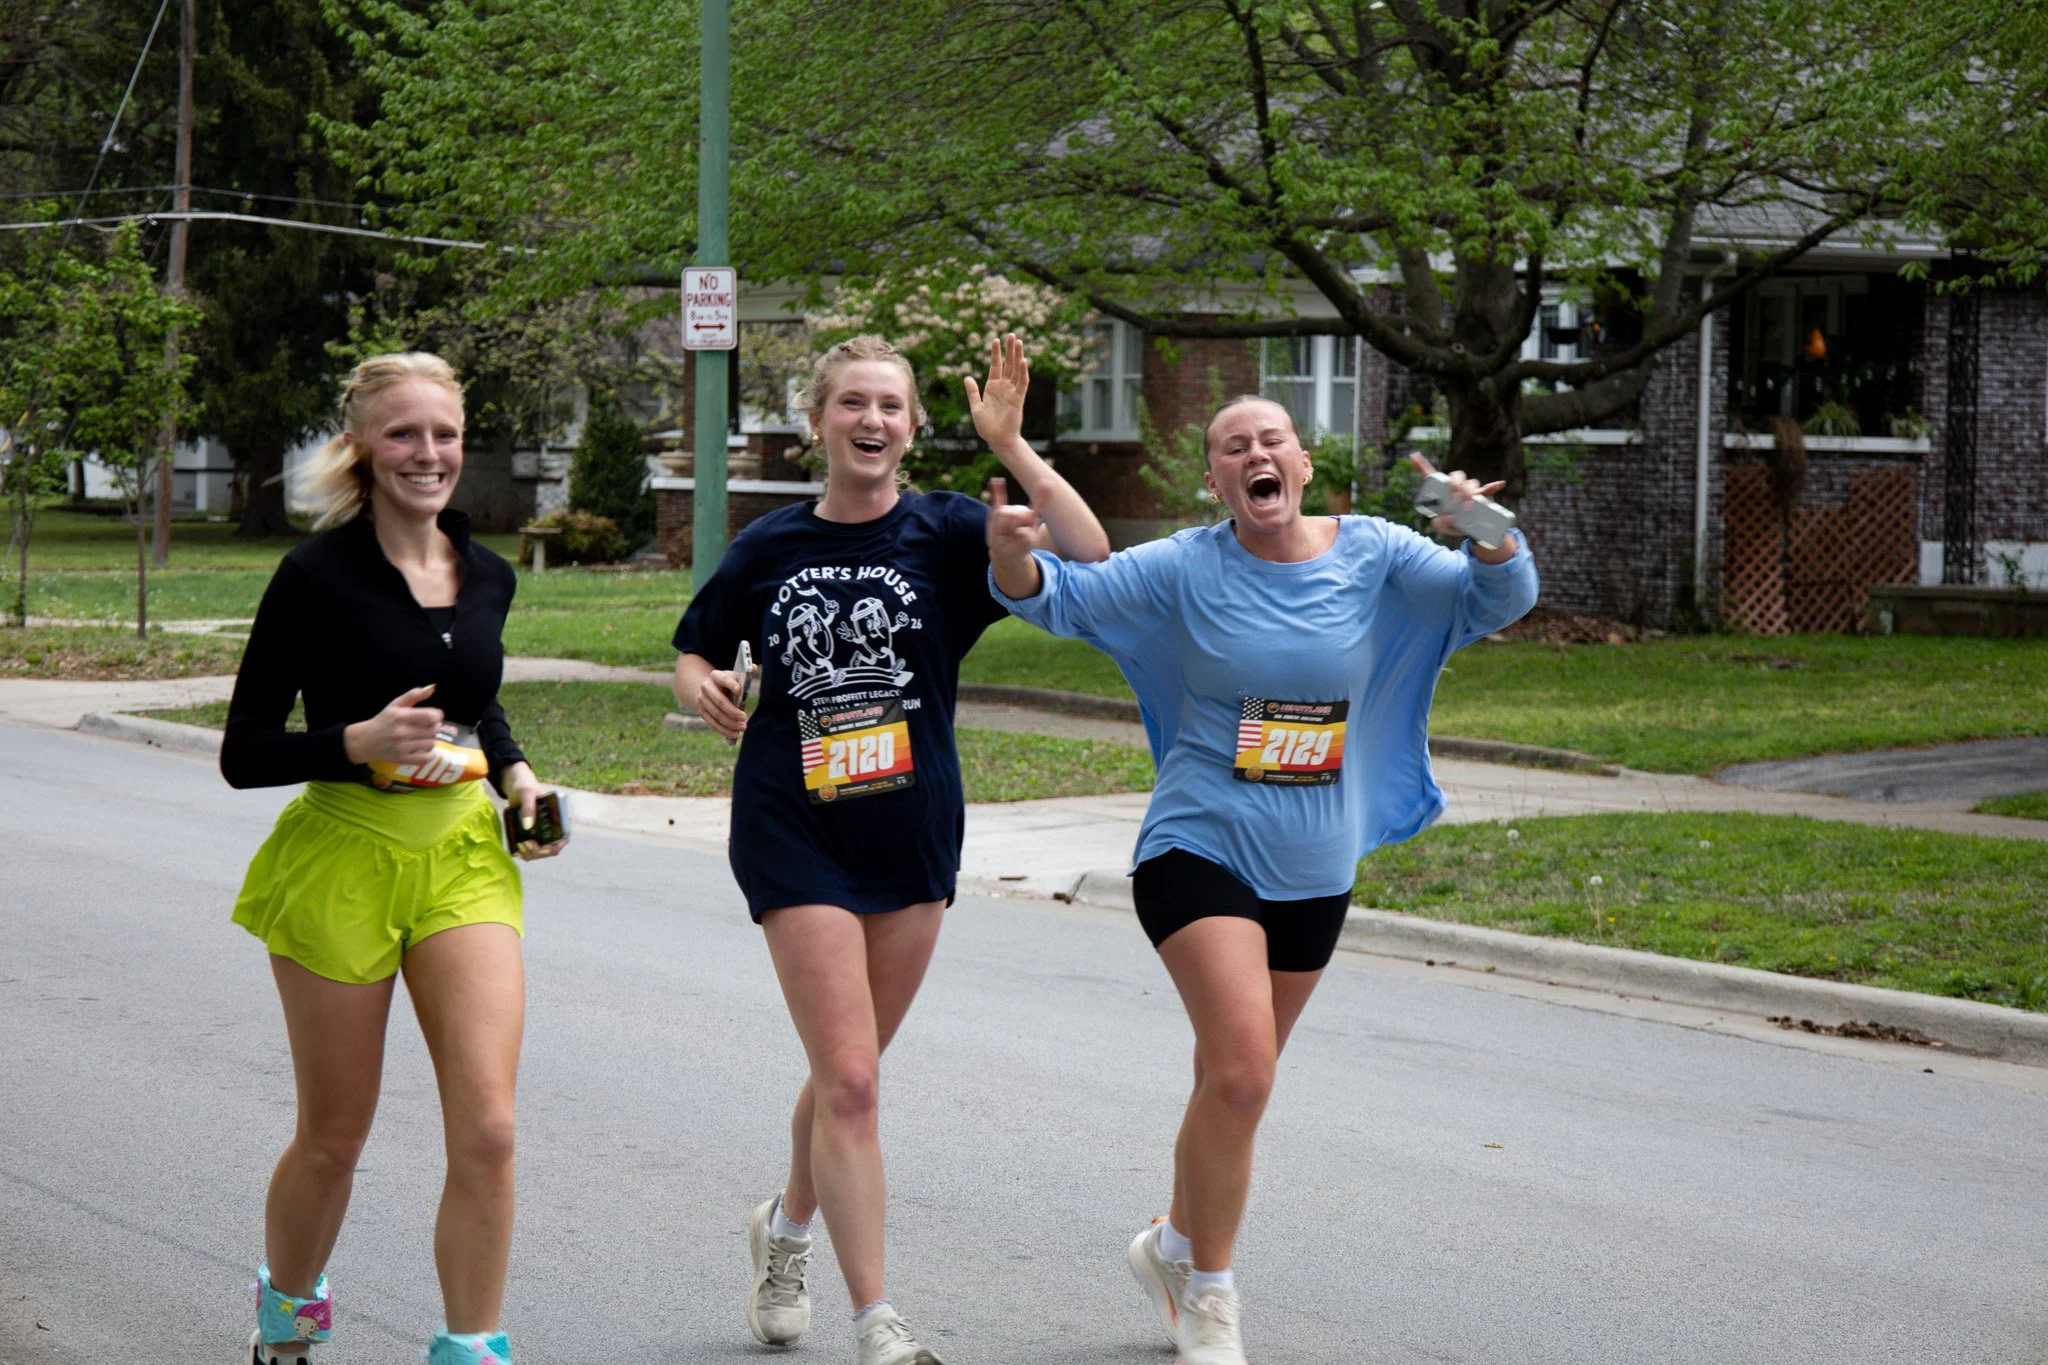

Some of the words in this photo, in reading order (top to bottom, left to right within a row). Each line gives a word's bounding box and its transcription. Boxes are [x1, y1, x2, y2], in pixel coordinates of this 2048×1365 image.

[699, 276, 718, 290] NO
[687, 293, 731, 307] PARKING
[770, 566, 852, 616] POTTER'S
[856, 566, 918, 606] HOUSE
[911, 618, 923, 629] 26
[767, 633, 780, 647] 20
[832, 691, 867, 703] PROFFITT
[902, 698, 921, 710] RUN
[1261, 728, 1333, 766] 2129
[828, 731, 895, 779] 2120
